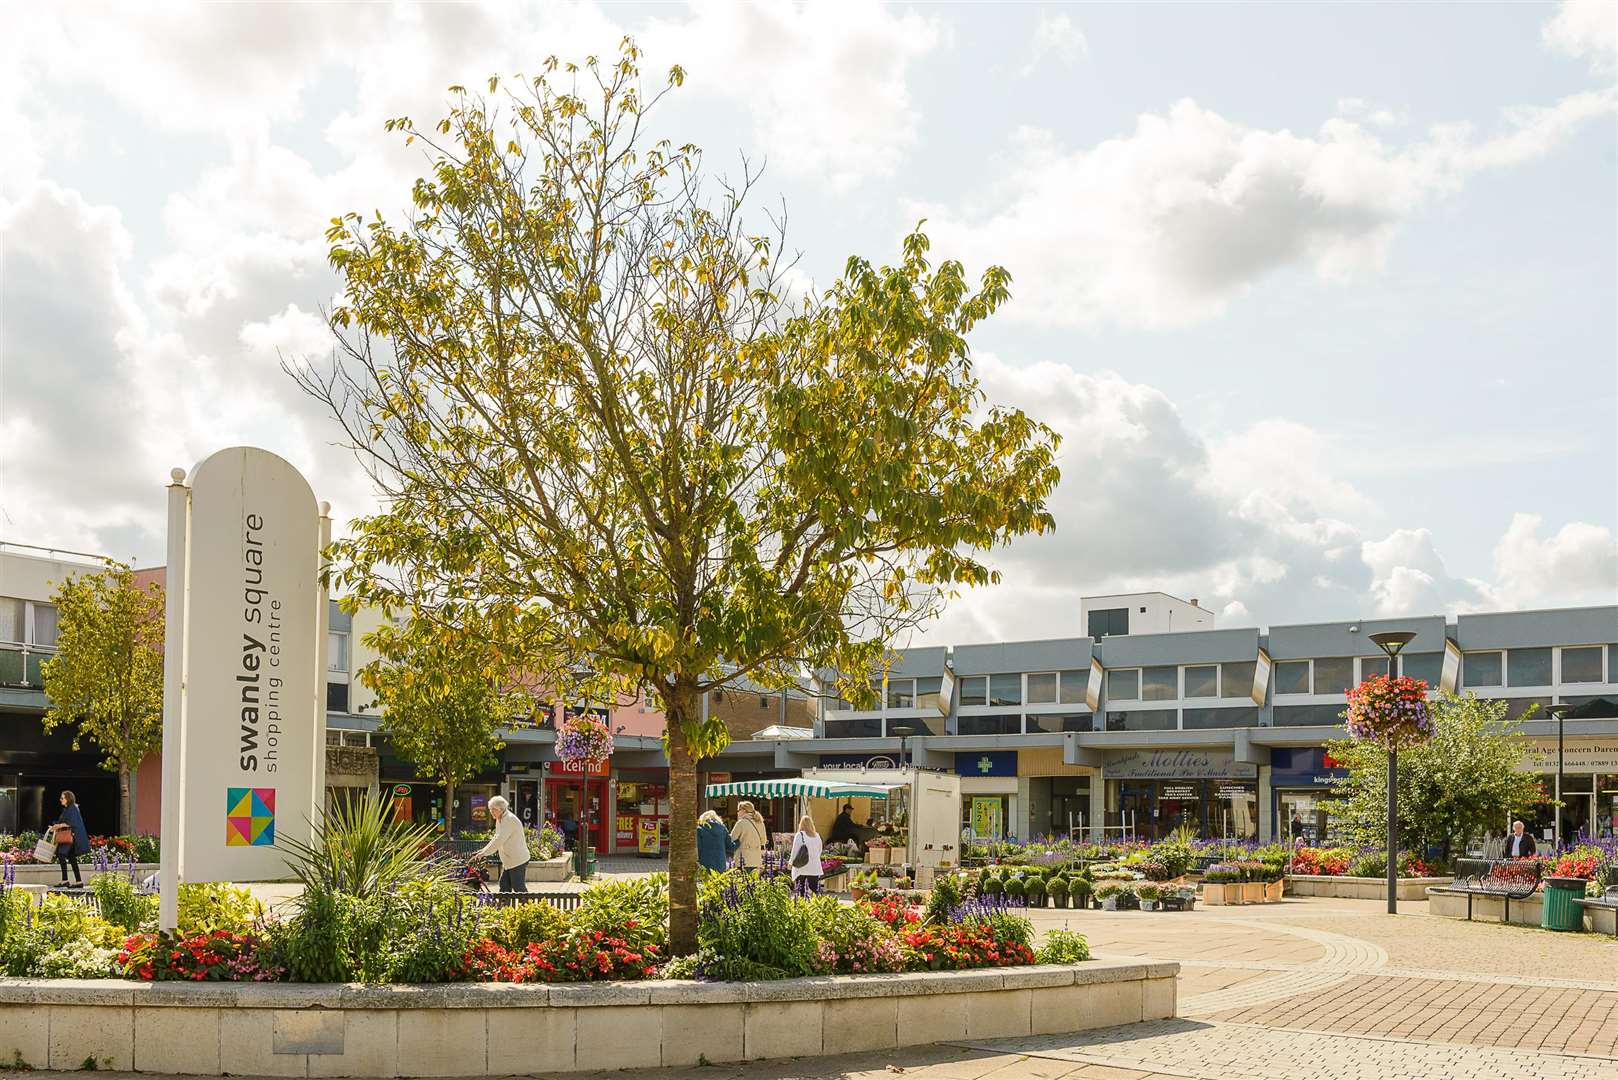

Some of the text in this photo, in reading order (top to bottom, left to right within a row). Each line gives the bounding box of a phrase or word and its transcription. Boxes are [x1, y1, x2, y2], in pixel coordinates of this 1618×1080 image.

[236, 513, 269, 772] swanley square
[263, 599, 284, 773] shopping centre
[1541, 746, 1556, 754] Age
